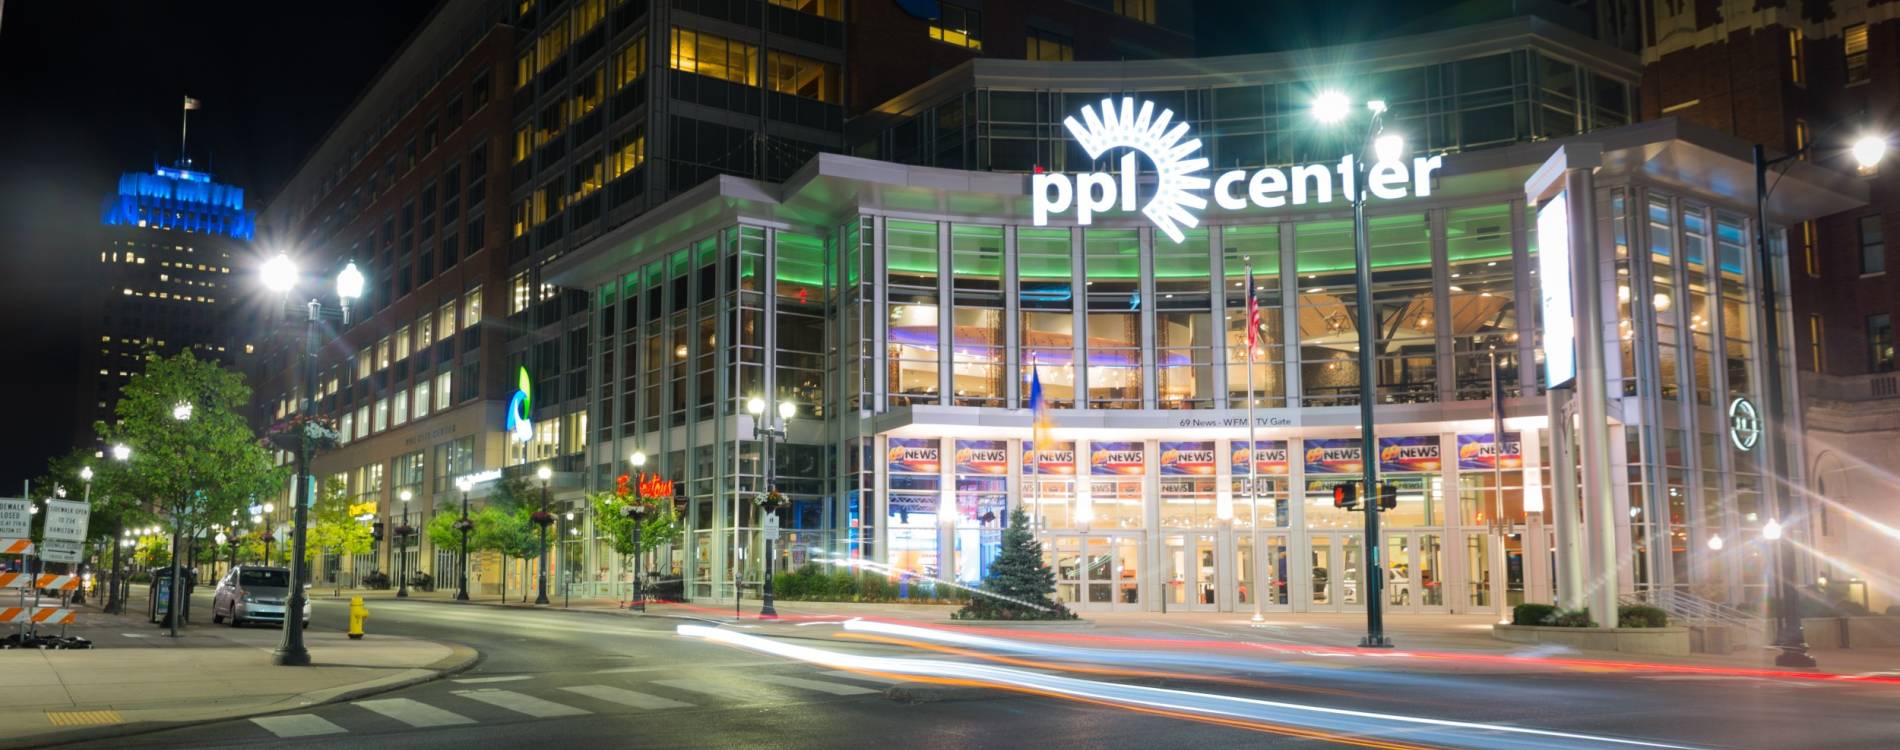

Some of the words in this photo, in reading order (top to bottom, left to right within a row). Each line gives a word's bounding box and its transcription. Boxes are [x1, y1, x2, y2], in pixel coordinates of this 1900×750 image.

[1033, 151, 1136, 226] ppl
[1214, 154, 1443, 210] center
[1179, 419, 1190, 427] 69
[1193, 418, 1216, 427] News
[1223, 418, 1248, 426] WFM
[1256, 418, 1268, 426] TV
[1270, 417, 1291, 426] Gate
[1400, 447, 1437, 457] NEWS
[1480, 443, 1519, 454] NEWS
[905, 449, 937, 459] NEWS
[972, 451, 1005, 461] NEWS
[1040, 451, 1072, 461] NEWS
[1109, 452, 1142, 461] NEWS
[1178, 451, 1212, 461] NEWS
[1323, 449, 1360, 459] NEWS
